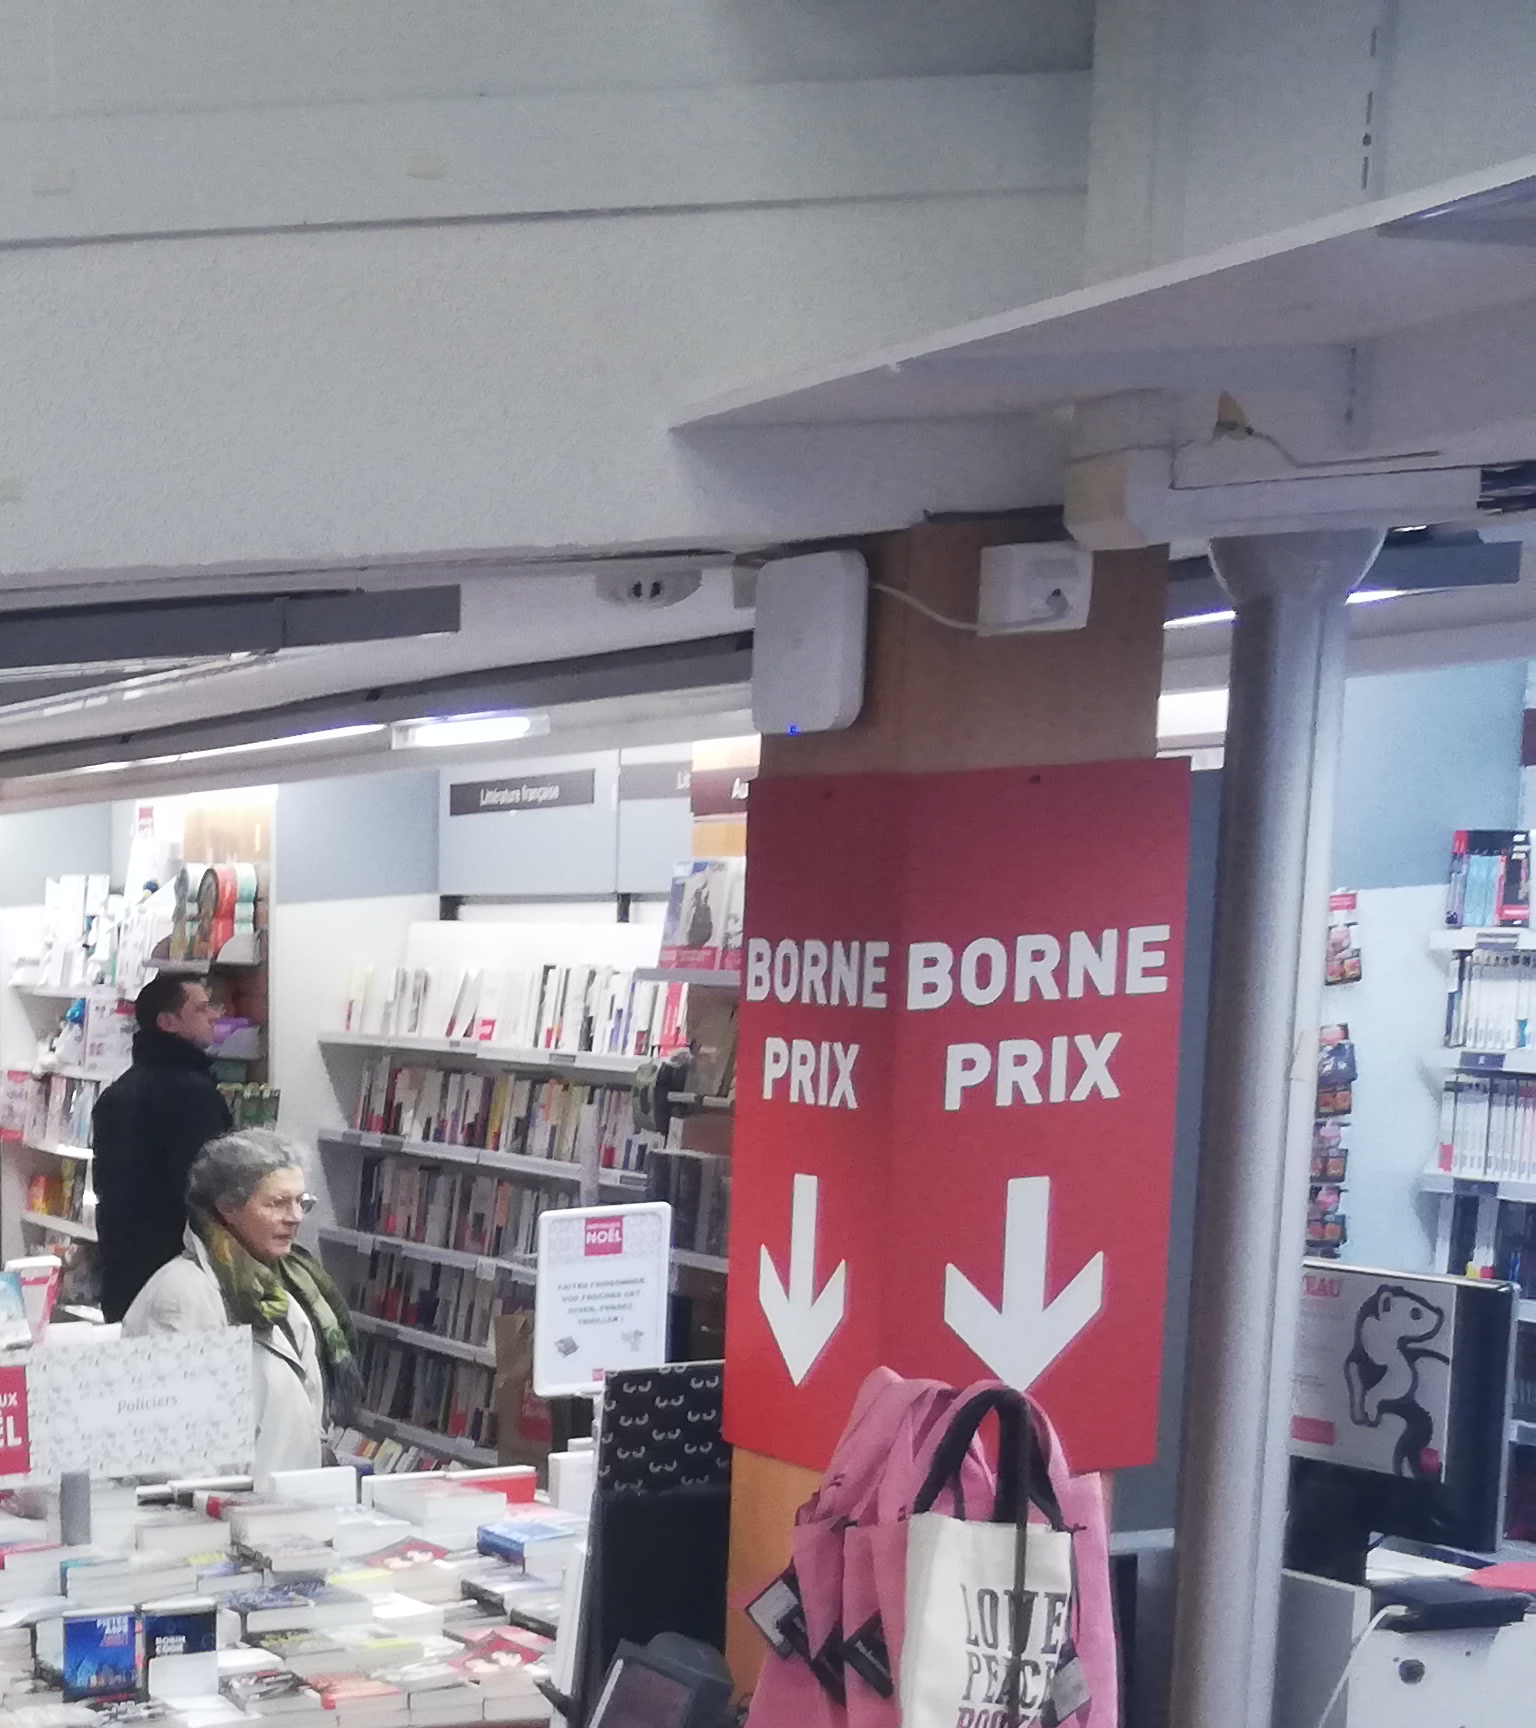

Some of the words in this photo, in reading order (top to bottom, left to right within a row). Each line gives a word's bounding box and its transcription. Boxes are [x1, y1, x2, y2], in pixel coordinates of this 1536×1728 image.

[746, 936, 891, 1009] BORNE
[906, 924, 1172, 1011] BORNE
[762, 1036, 860, 1109] PRIX
[943, 1031, 1122, 1111] PRIX
[585, 1226, 623, 1245] NOËL
[116, 1394, 179, 1416] Policiers
[960, 1583, 1068, 1655] LOVE
